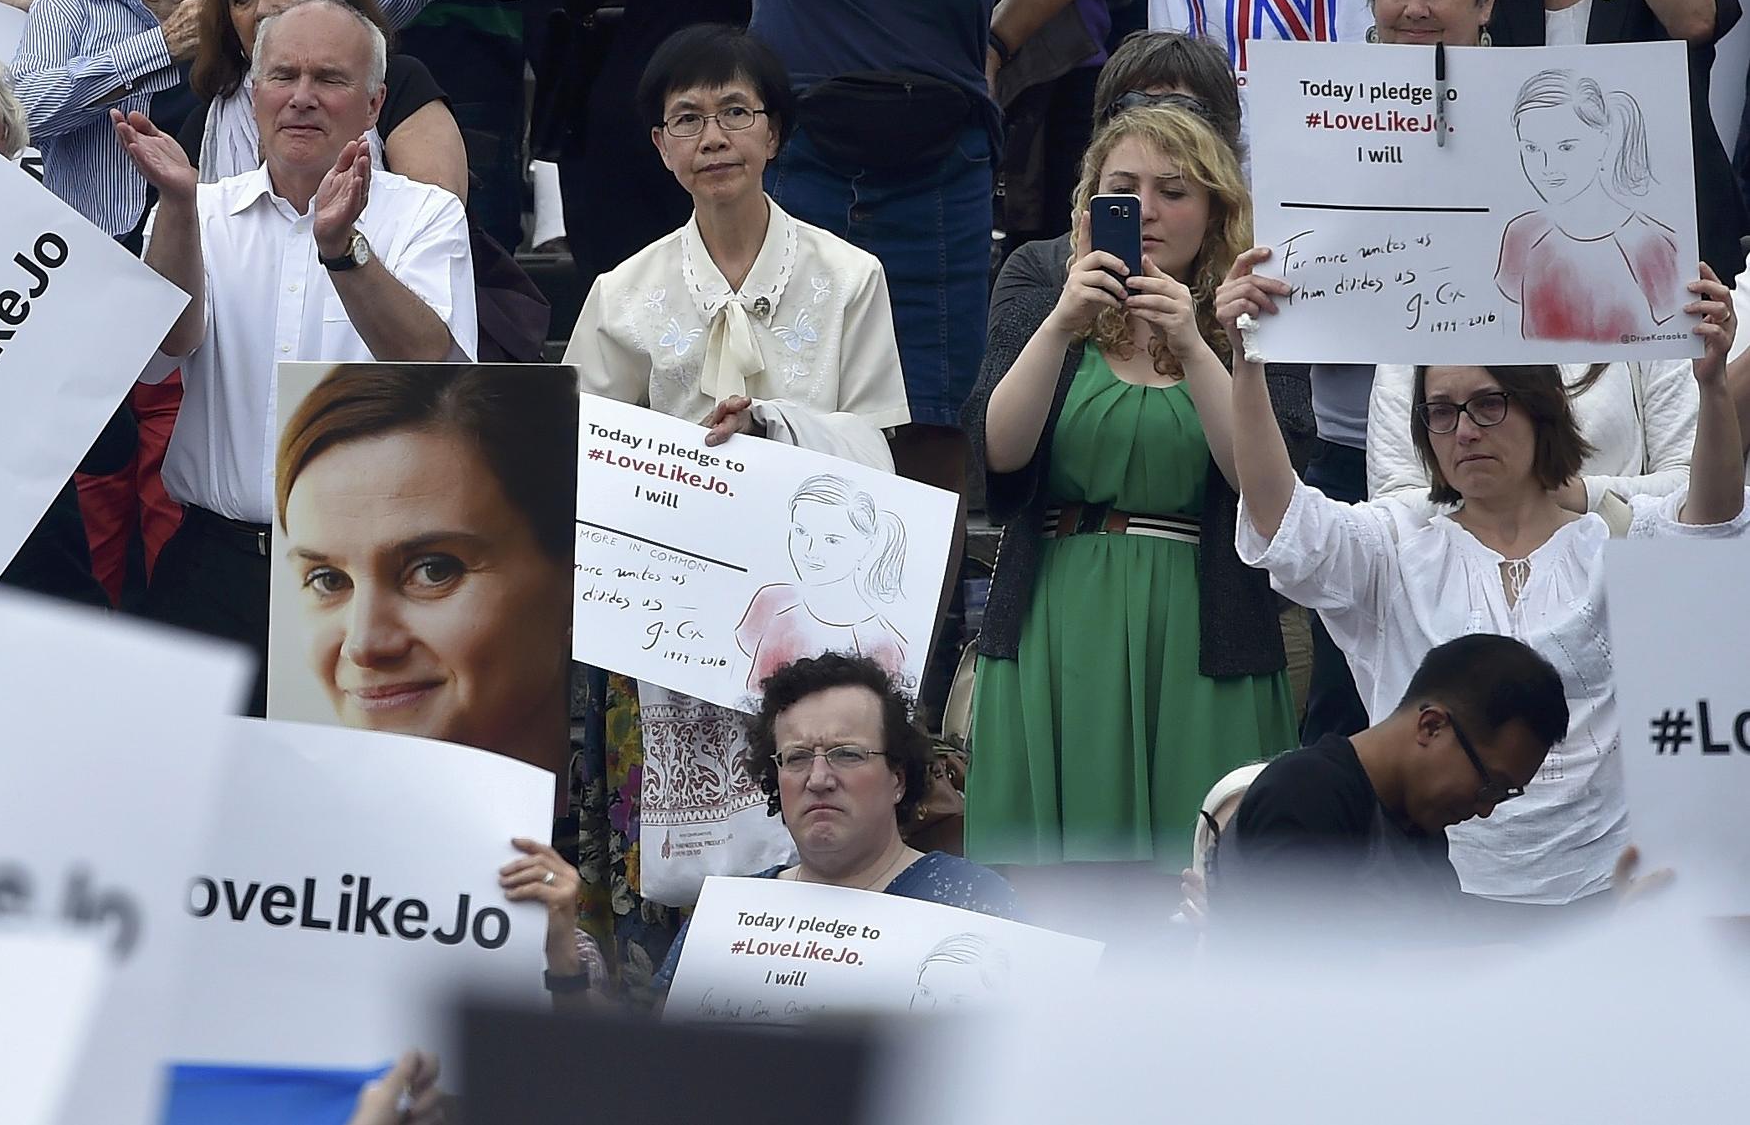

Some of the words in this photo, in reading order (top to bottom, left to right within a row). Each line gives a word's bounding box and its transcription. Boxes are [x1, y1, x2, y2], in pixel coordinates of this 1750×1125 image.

[1299, 79, 1354, 102] Today
[1359, 83, 1365, 98] I
[1370, 82, 1433, 106] pledge
[1357, 146, 1363, 162] I
[1367, 145, 1403, 164] will
[1277, 230, 1315, 277] Far
[1315, 251, 1348, 265] more
[1358, 235, 1407, 260] unites
[1415, 233, 1433, 248] us
[1288, 275, 1326, 306] than
[1335, 270, 1384, 294] divides
[1394, 270, 1416, 286] us
[588, 423, 643, 449] Today
[647, 438, 653, 450] I
[657, 442, 720, 467] pledge
[725, 458, 745, 473] to
[587, 448, 735, 498] #LoveLikeJo.
[634, 485, 641, 498] I
[645, 489, 679, 509] will
[579, 529, 618, 547] MORE
[629, 542, 642, 552] IN
[650, 549, 709, 573] COMMON
[613, 564, 662, 583] unites
[671, 574, 688, 586] us
[581, 583, 631, 610] divides
[641, 597, 663, 611] us
[737, 911, 786, 932] Today
[787, 915, 795, 929] I
[796, 916, 858, 939] pledge
[861, 925, 881, 940] to
[730, 938, 864, 966] #LoveLikeJo.
[765, 970, 772, 984] I
[775, 970, 807, 987] will
